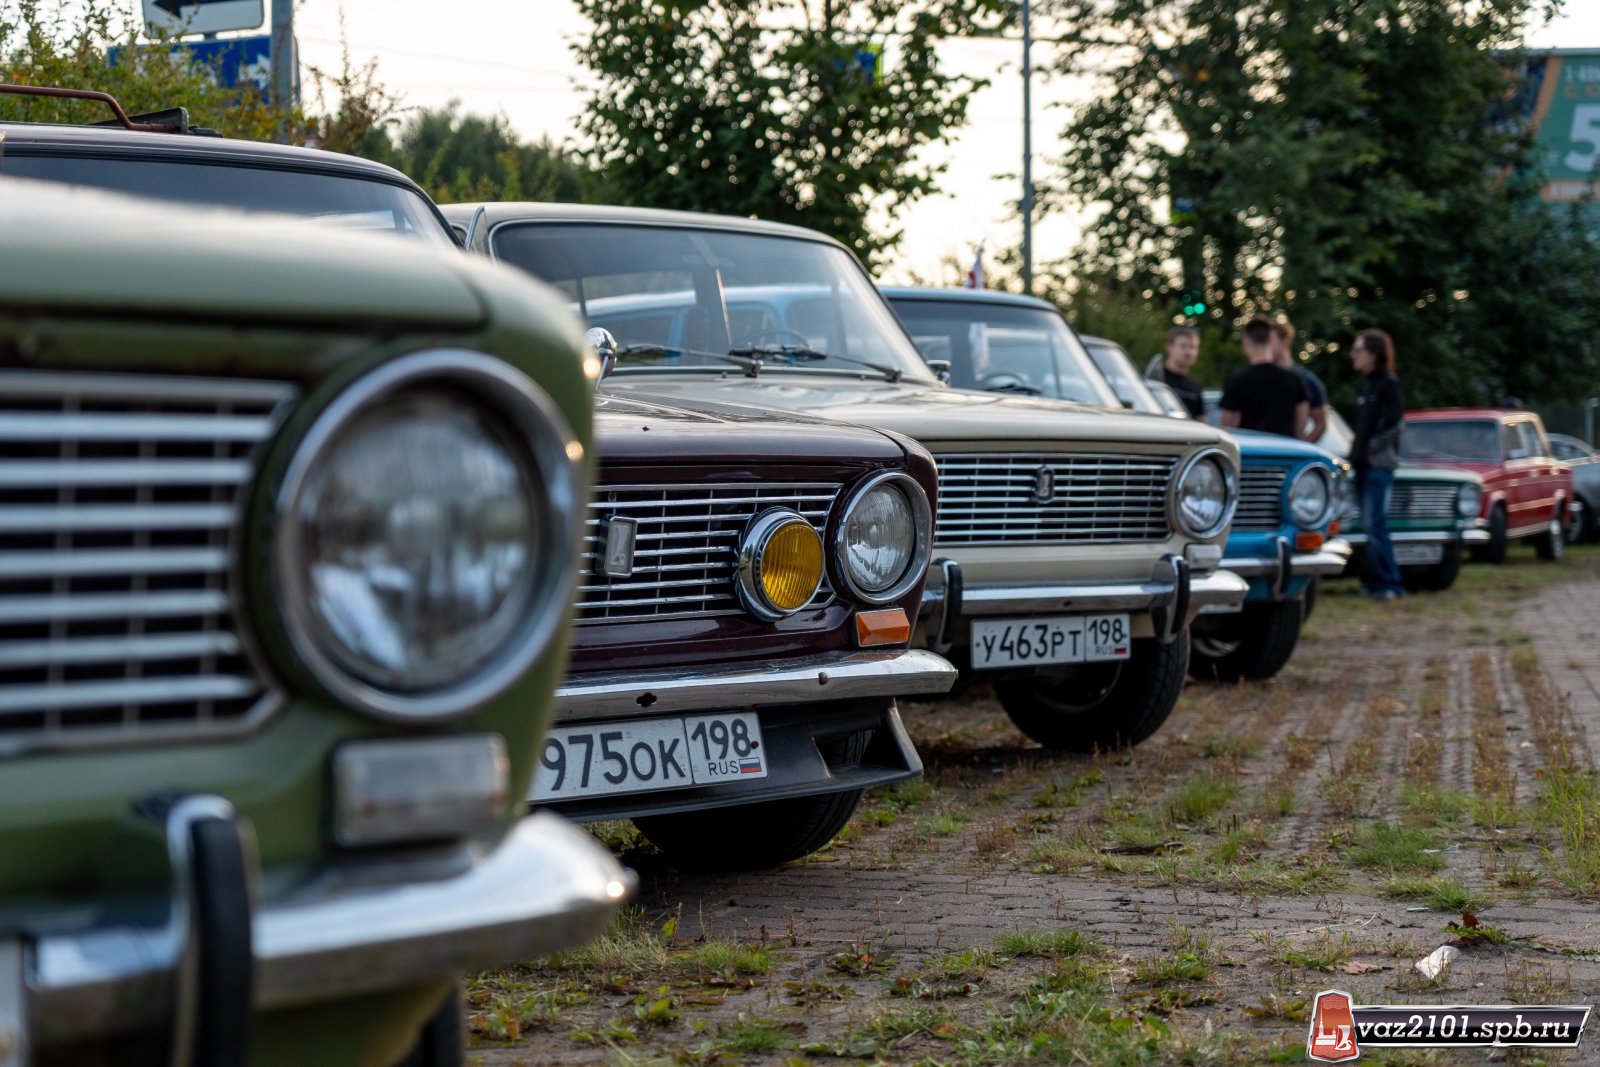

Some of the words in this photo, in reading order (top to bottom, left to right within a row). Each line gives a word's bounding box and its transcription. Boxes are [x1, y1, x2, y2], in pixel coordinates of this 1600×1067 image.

[982, 624, 1081, 662] У463РТ
[1088, 618, 1123, 645] 198
[691, 718, 750, 760] 198
[708, 761, 739, 776] RUS
